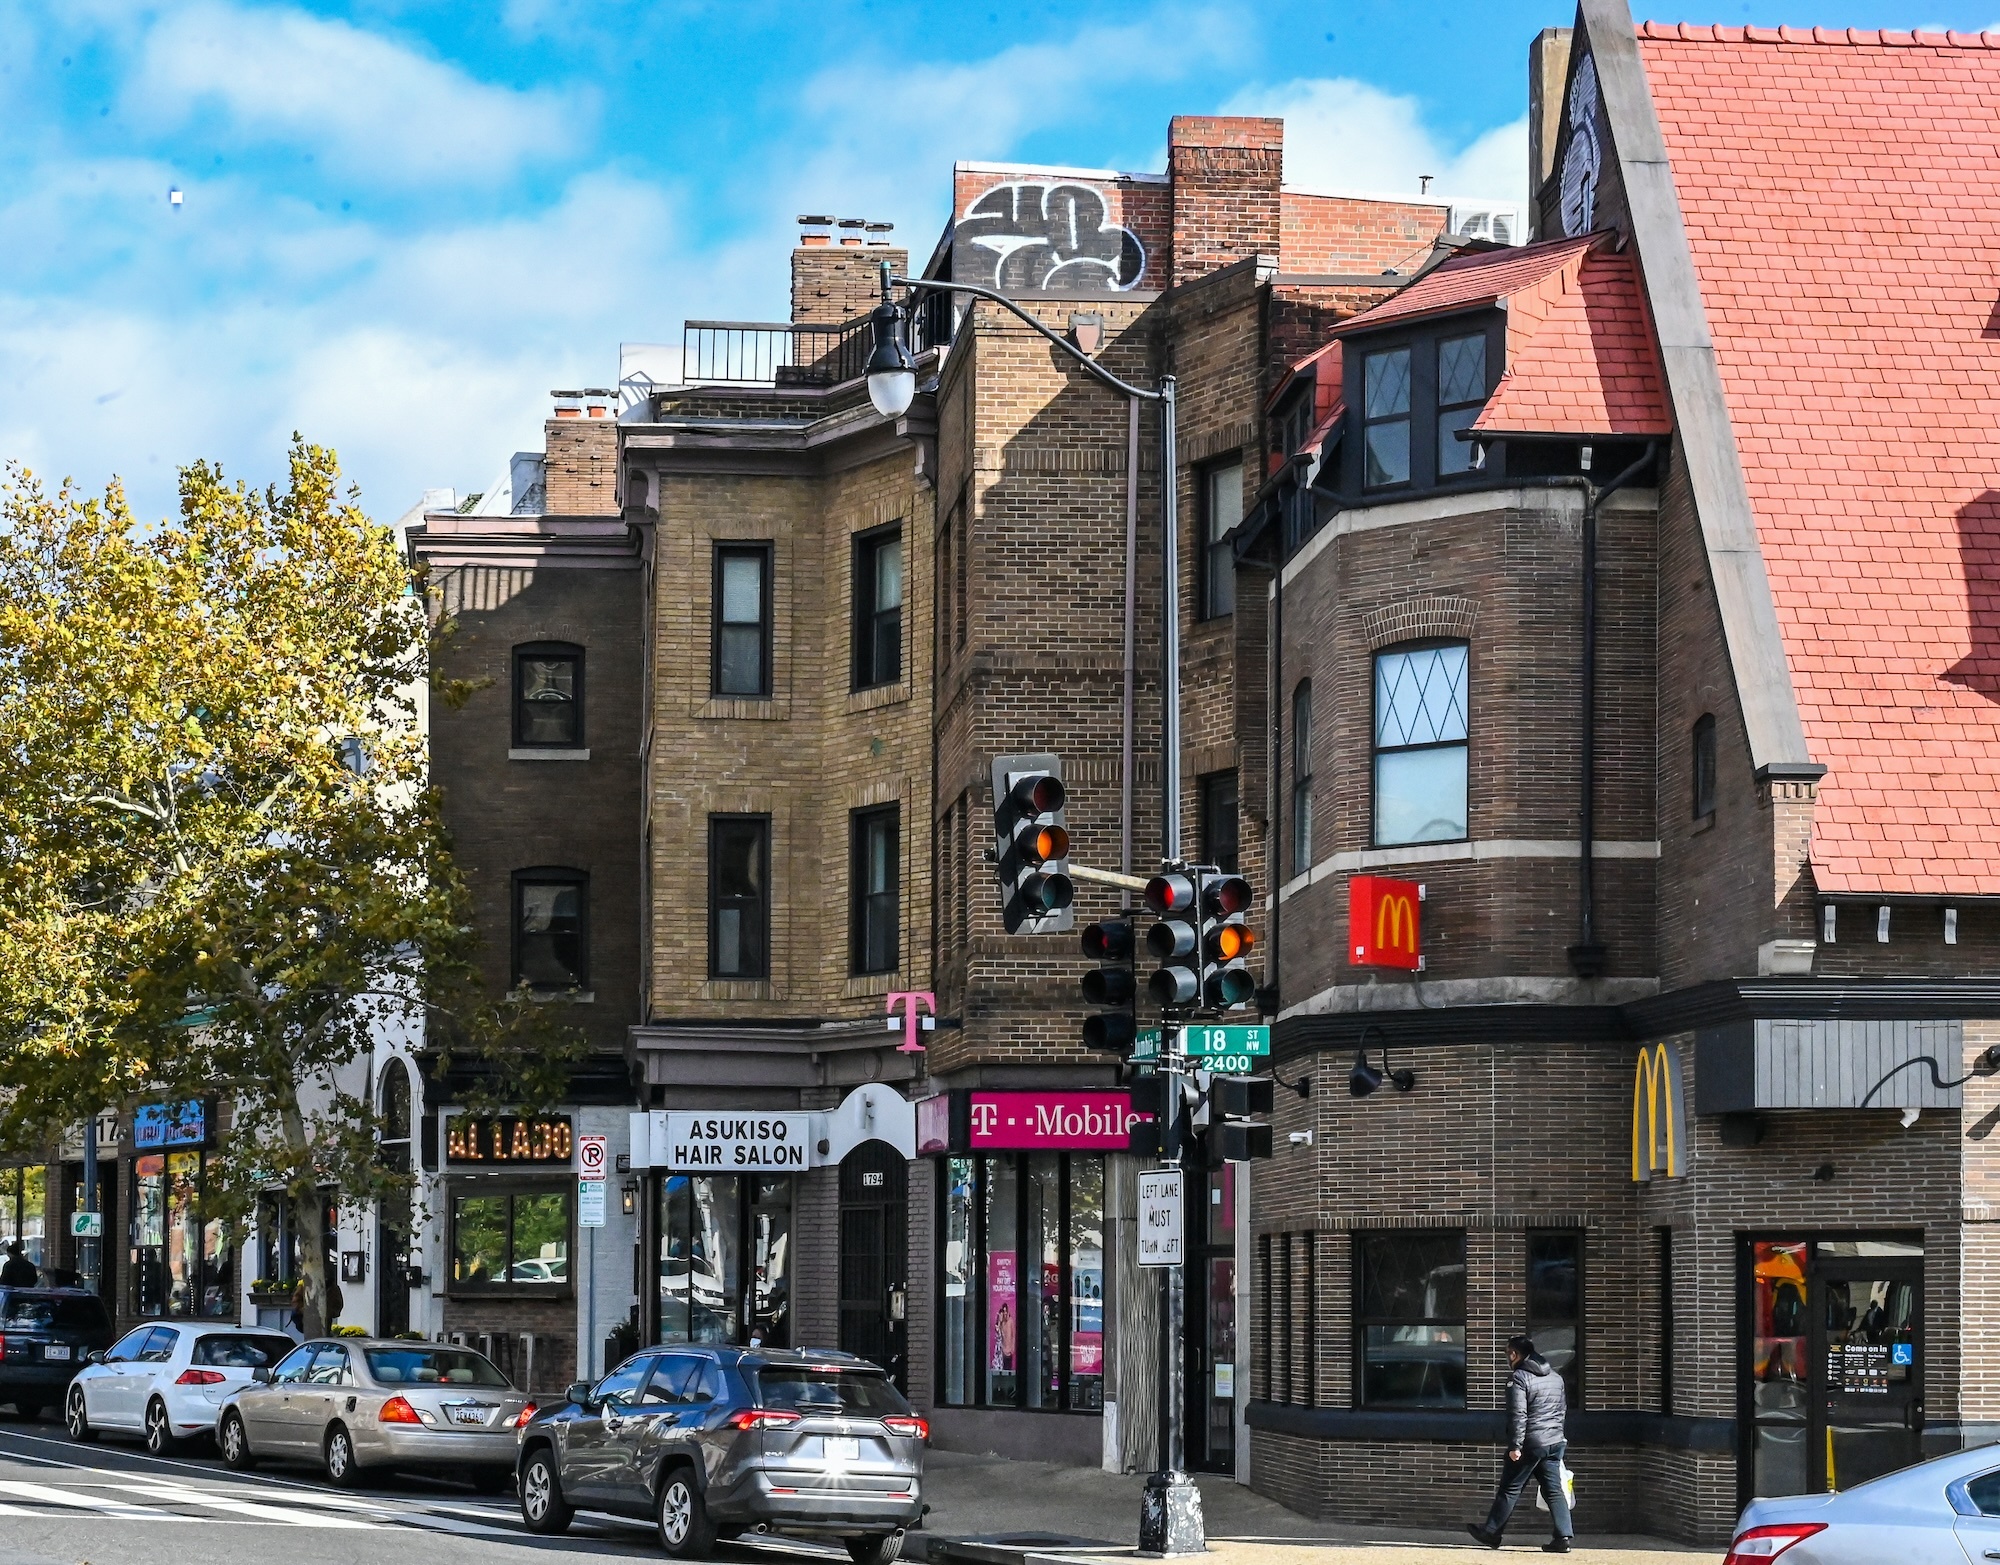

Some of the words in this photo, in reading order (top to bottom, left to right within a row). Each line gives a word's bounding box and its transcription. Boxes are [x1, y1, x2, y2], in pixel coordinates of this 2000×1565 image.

[1203, 1029, 1226, 1051] 18
[1247, 1030, 1258, 1040] ST
[1246, 1041, 1260, 1051] NW
[1204, 1056, 1249, 1070] 2400
[689, 1120, 788, 1141] ASUKISQ
[448, 1122, 484, 1159] AL
[493, 1121, 572, 1159] LADO
[675, 1145, 722, 1165] HAIR
[733, 1145, 803, 1165] SALON
[864, 1174, 883, 1185] 1794
[1142, 1184, 1158, 1199] LEFT
[1161, 1183, 1178, 1198] LANE
[1148, 1209, 1171, 1227] MUST
[1844, 1344, 1868, 1352] Come
[1879, 1344, 1888, 1352] in
